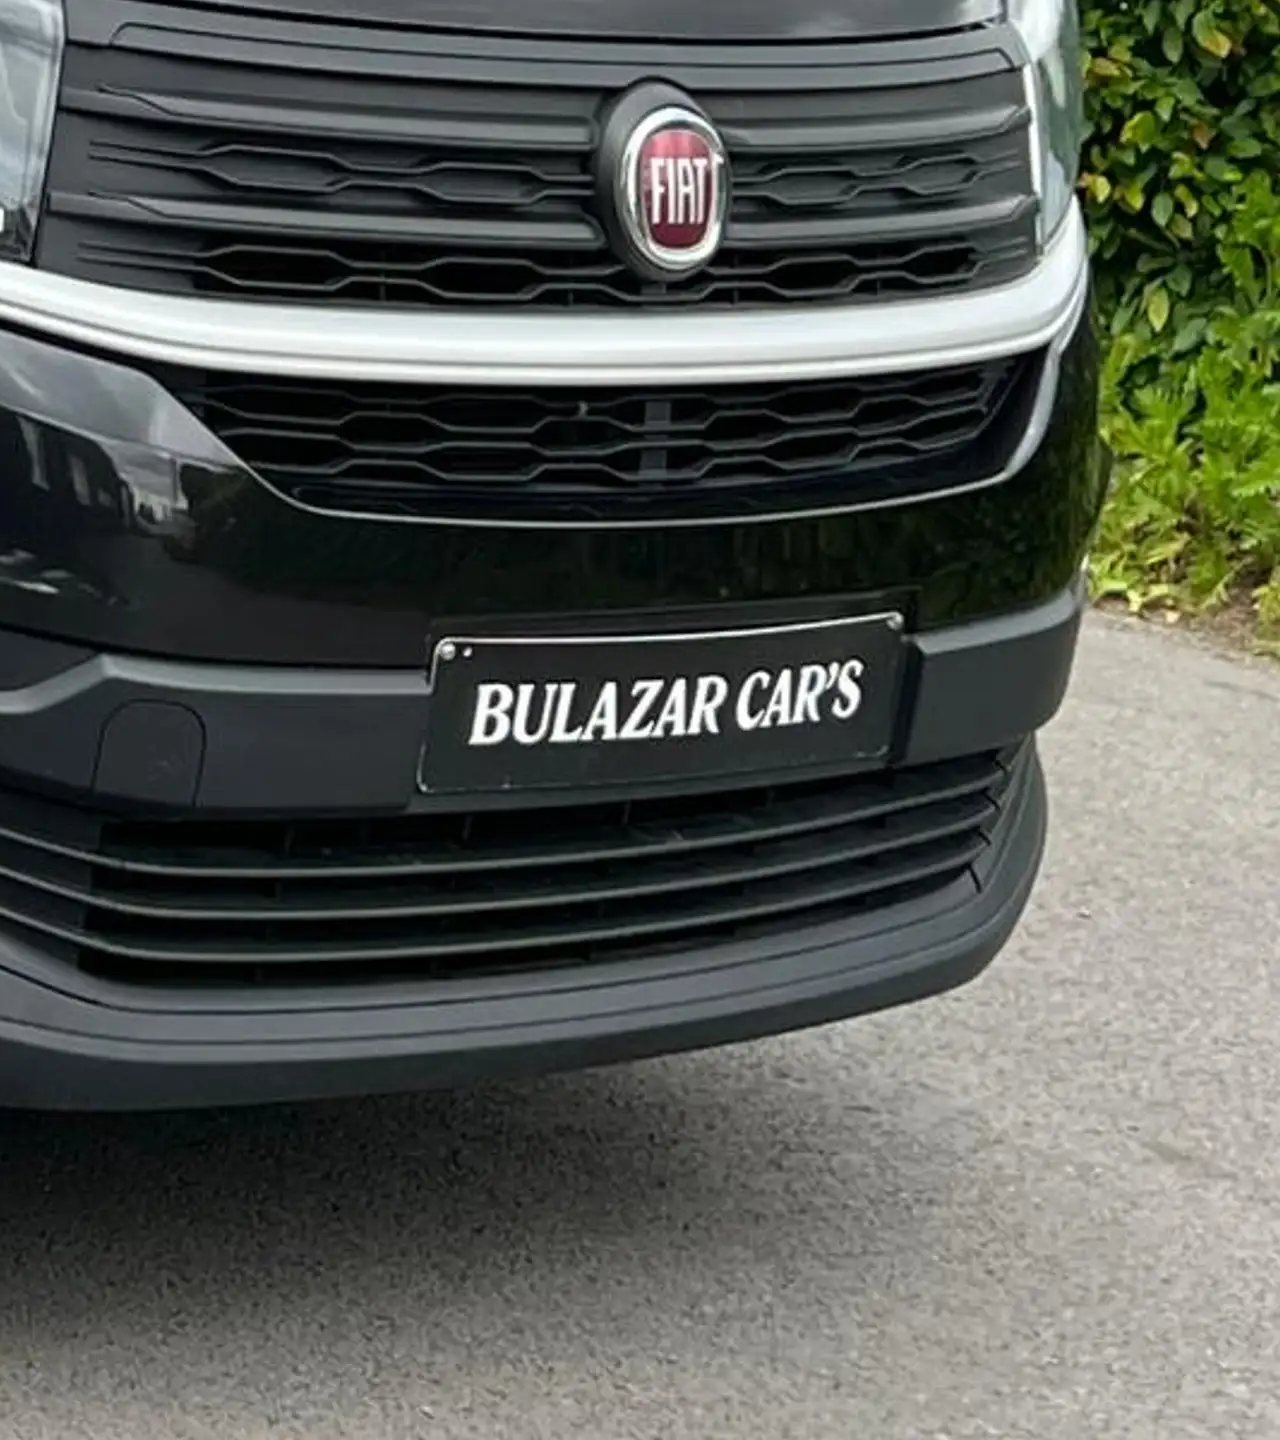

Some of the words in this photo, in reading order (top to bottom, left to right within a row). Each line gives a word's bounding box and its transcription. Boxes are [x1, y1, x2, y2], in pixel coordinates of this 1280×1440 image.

[649, 156, 708, 225] FIAT
[468, 673, 727, 746] BULAZAR
[736, 659, 864, 731] CAR'S
